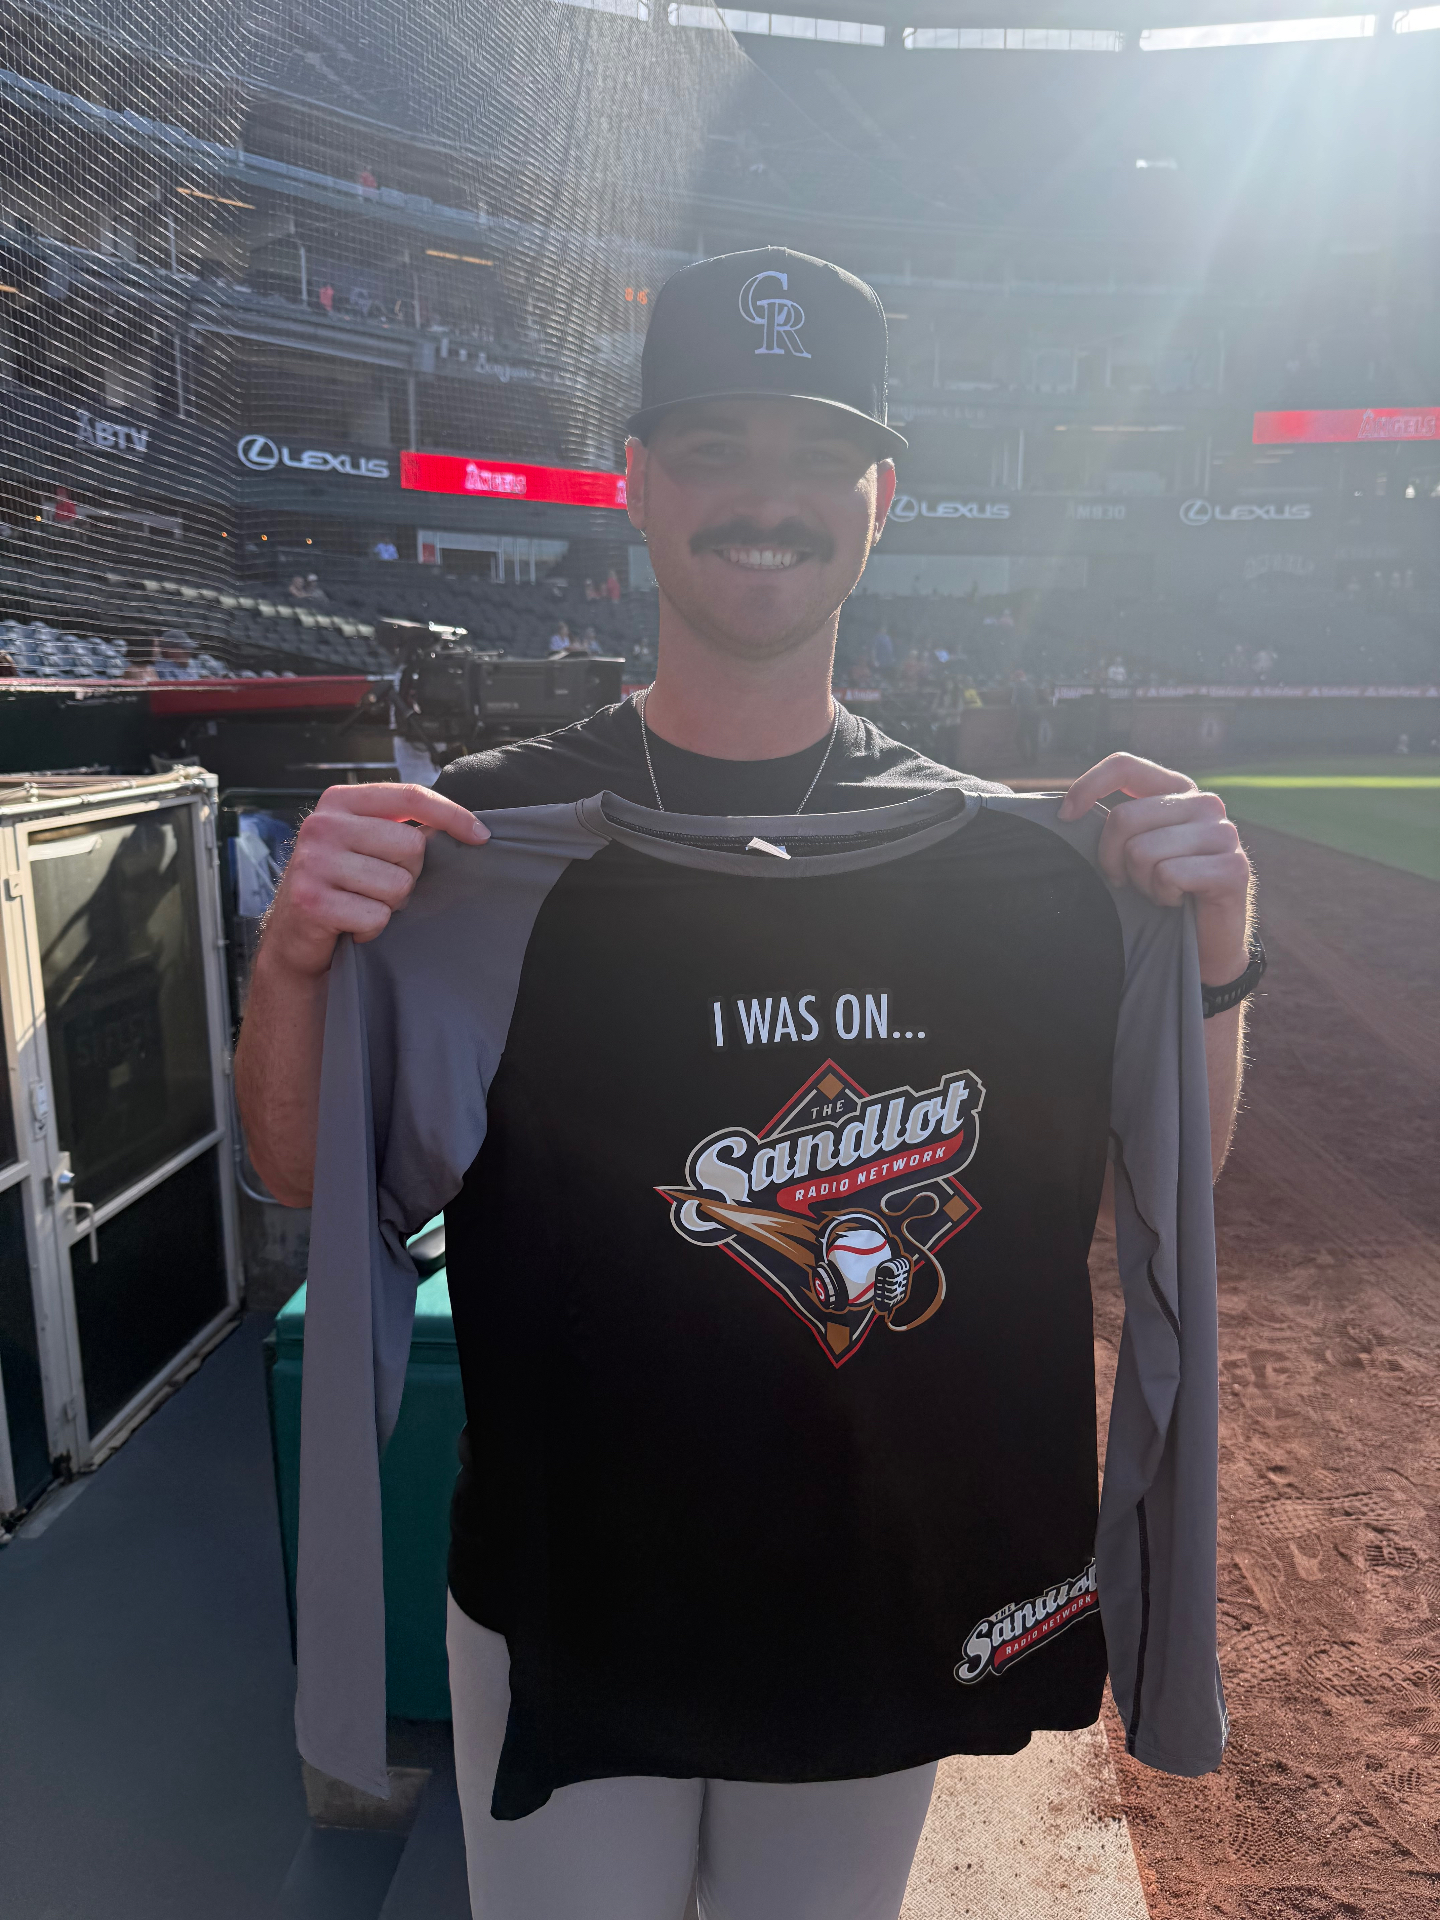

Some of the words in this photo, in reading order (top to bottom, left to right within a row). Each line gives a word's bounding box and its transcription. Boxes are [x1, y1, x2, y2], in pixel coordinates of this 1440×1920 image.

[281, 446, 391, 479] LEXUS
[919, 502, 1011, 520] LEXUS
[1214, 502, 1312, 521] LEXUS
[713, 1001, 724, 1047] I
[736, 995, 820, 1045] WAS
[835, 993, 926, 1041] ON...
[810, 1099, 845, 1120] THE
[680, 1080, 970, 1231] Sandlot
[794, 1178, 850, 1202] RADIO
[856, 1146, 946, 1186] NETWORK
[994, 1604, 1014, 1621] THE
[1005, 1631, 1038, 1655] RADIO
[1042, 1594, 1092, 1633] NETWORK
